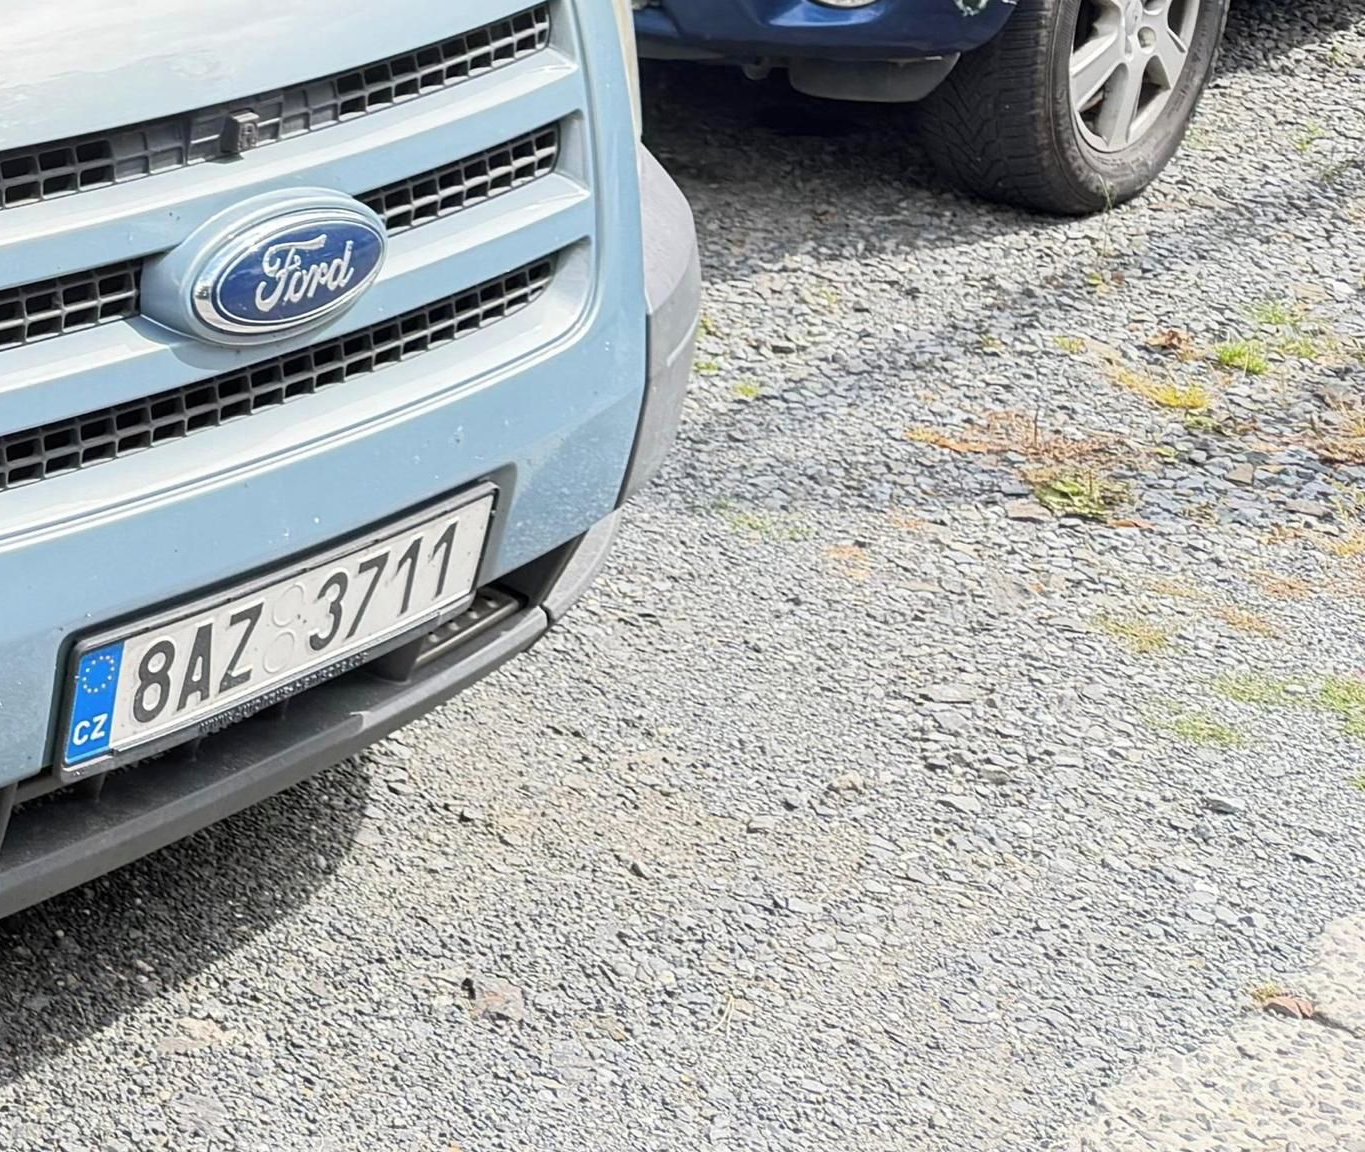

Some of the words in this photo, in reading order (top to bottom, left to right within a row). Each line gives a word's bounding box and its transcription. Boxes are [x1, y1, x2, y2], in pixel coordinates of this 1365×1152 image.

[255, 234, 355, 313] Ford
[132, 602, 265, 724] 8AZ
[308, 521, 460, 652] 3711
[72, 712, 107, 747] CZ
